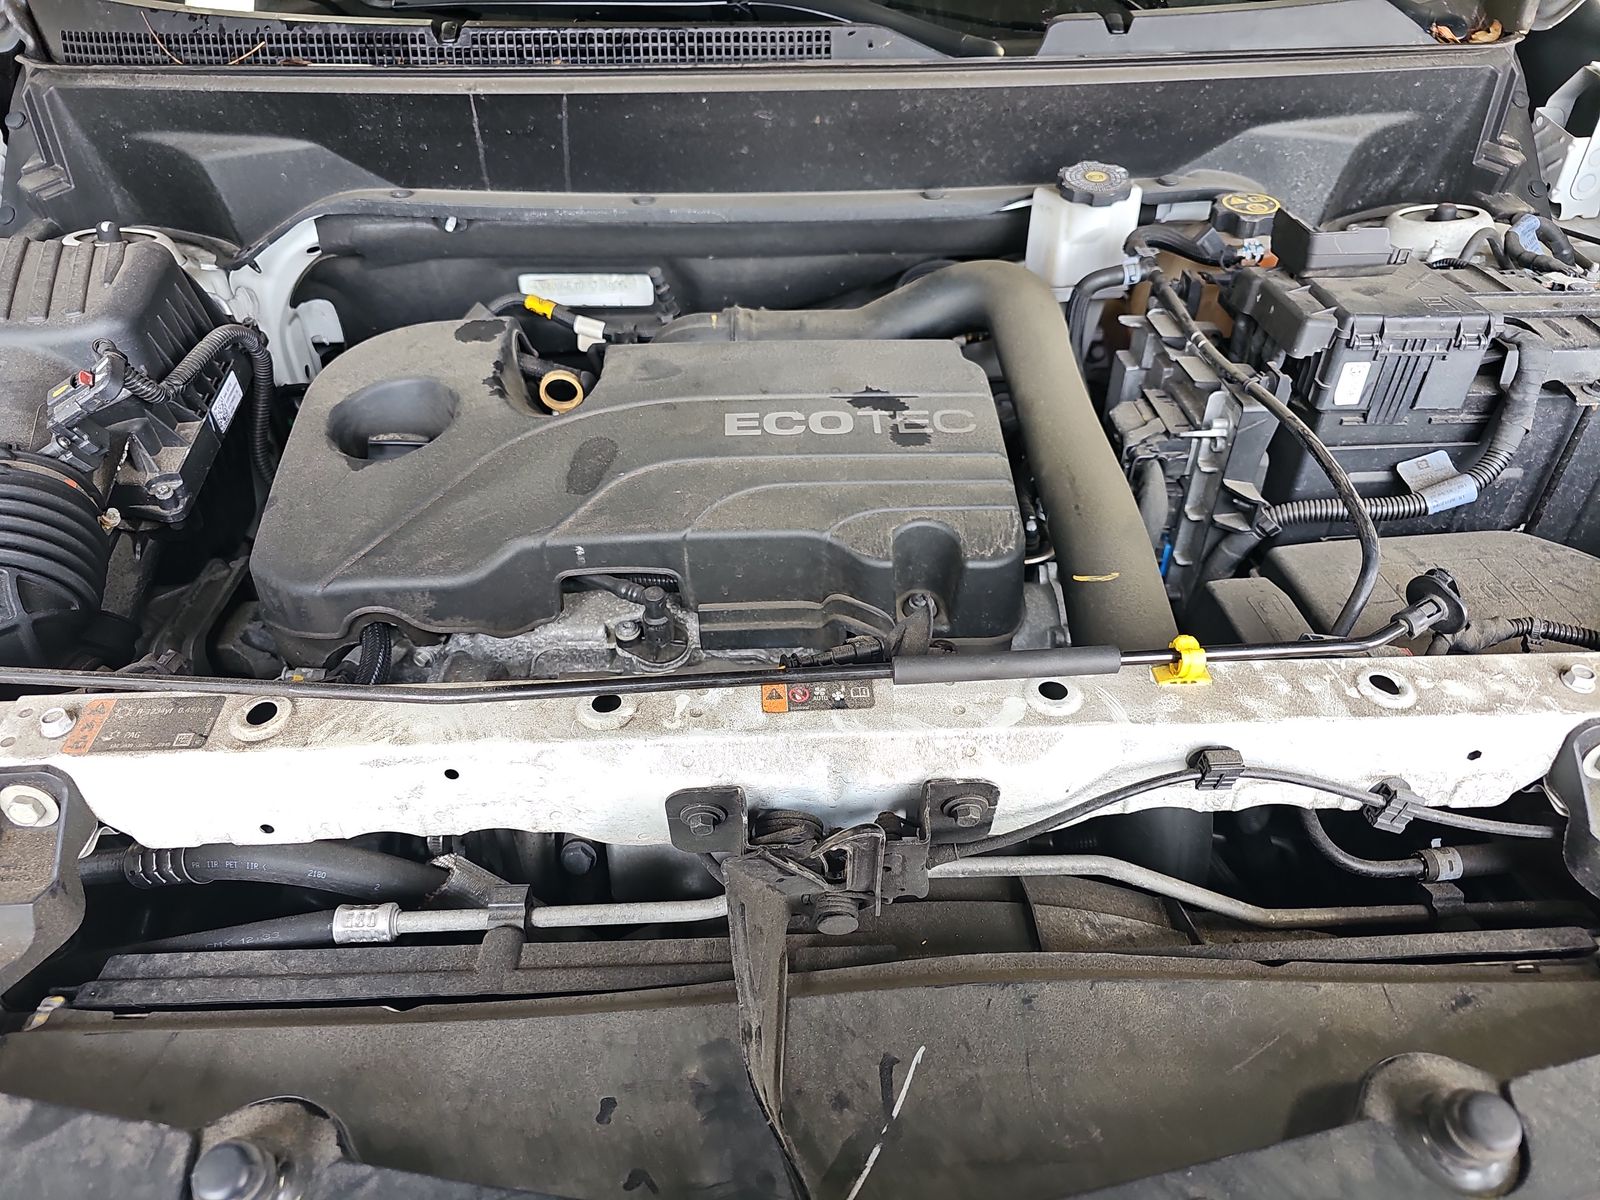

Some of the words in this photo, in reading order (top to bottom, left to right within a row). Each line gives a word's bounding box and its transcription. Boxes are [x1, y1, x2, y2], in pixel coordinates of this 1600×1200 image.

[724, 409, 978, 436] ECOTEC
[124, 731, 142, 739] PAG
[225, 861, 237, 869] PET
[307, 869, 327, 879] 2180
